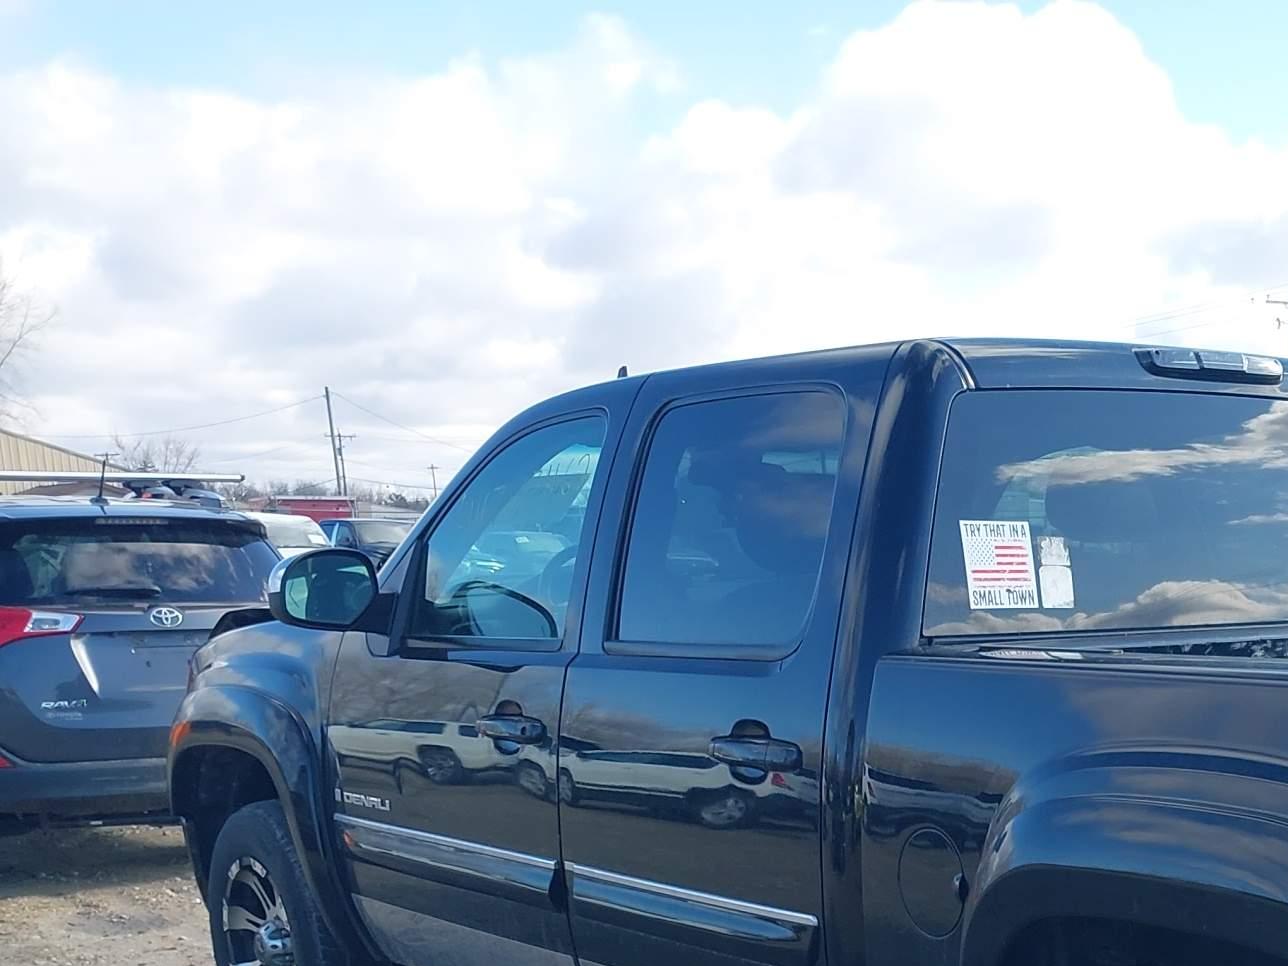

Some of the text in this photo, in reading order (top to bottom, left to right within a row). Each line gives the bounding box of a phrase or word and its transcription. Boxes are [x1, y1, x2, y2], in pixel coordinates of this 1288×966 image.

[963, 523, 1027, 538] TRY THAT IN A
[972, 588, 1035, 606] SMALL TOWN
[343, 791, 390, 811] DENALI
